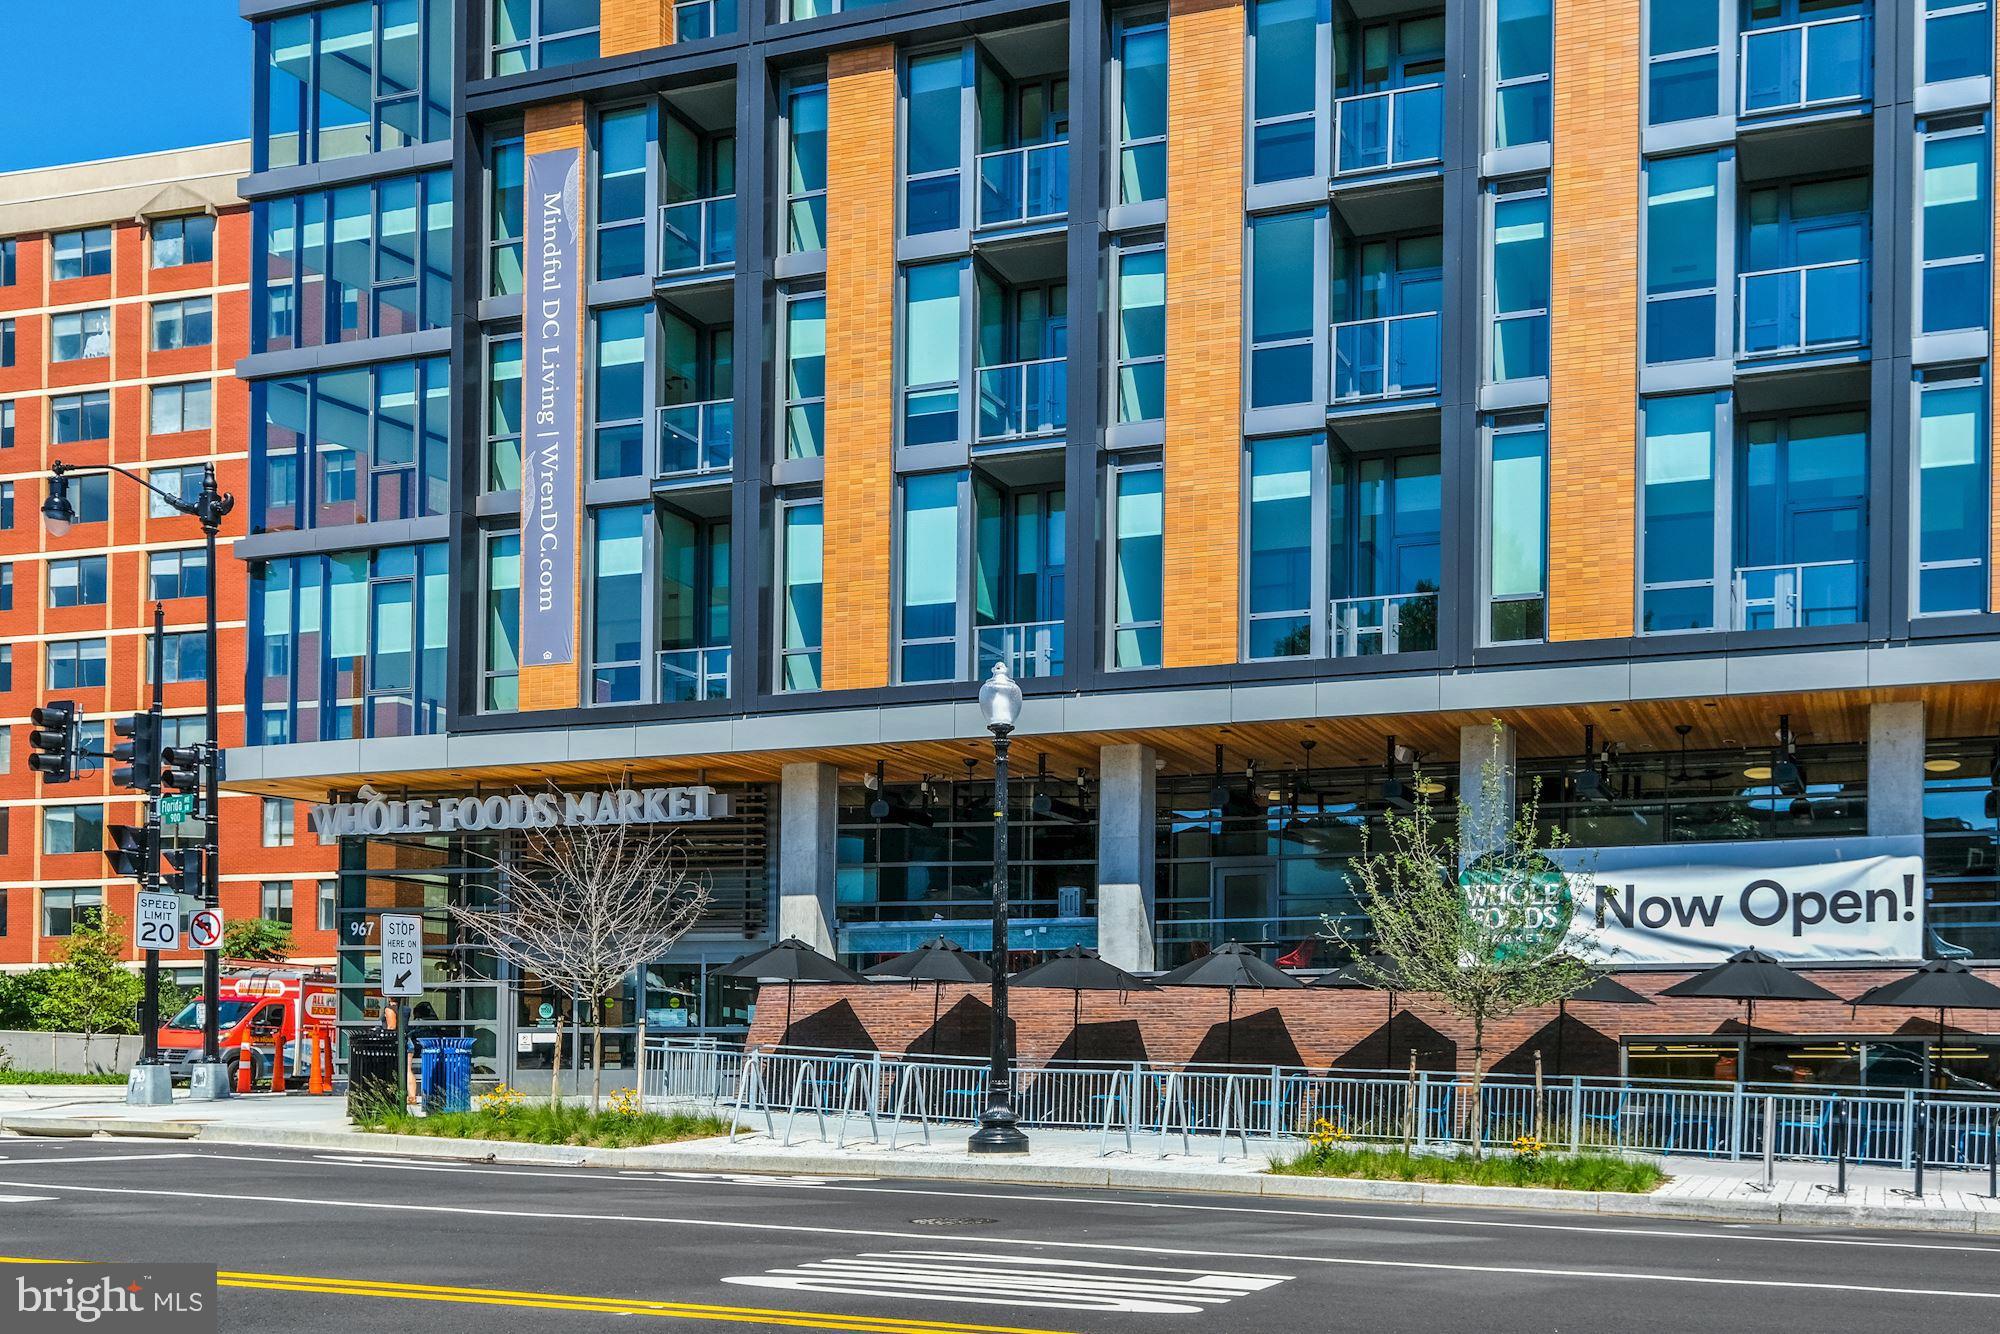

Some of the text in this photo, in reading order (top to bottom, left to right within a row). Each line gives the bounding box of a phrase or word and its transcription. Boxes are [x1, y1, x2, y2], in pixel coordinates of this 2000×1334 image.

[542, 191, 562, 293] Mindful
[541, 298, 561, 339] DC
[536, 344, 560, 425] Living
[539, 441, 559, 612] WrenDC.com
[161, 799, 183, 814] Florida
[311, 785, 717, 836] WHOLE FOODS MARKET
[170, 812, 181, 823] 900
[141, 898, 177, 910] SPEED
[1595, 873, 1916, 937] Now Open!
[144, 910, 172, 921] LIMIT
[141, 921, 174, 943] 20
[350, 921, 375, 936] 967
[388, 922, 415, 936] STOP
[387, 939, 417, 948] HERE ON
[391, 952, 413, 965] RED
